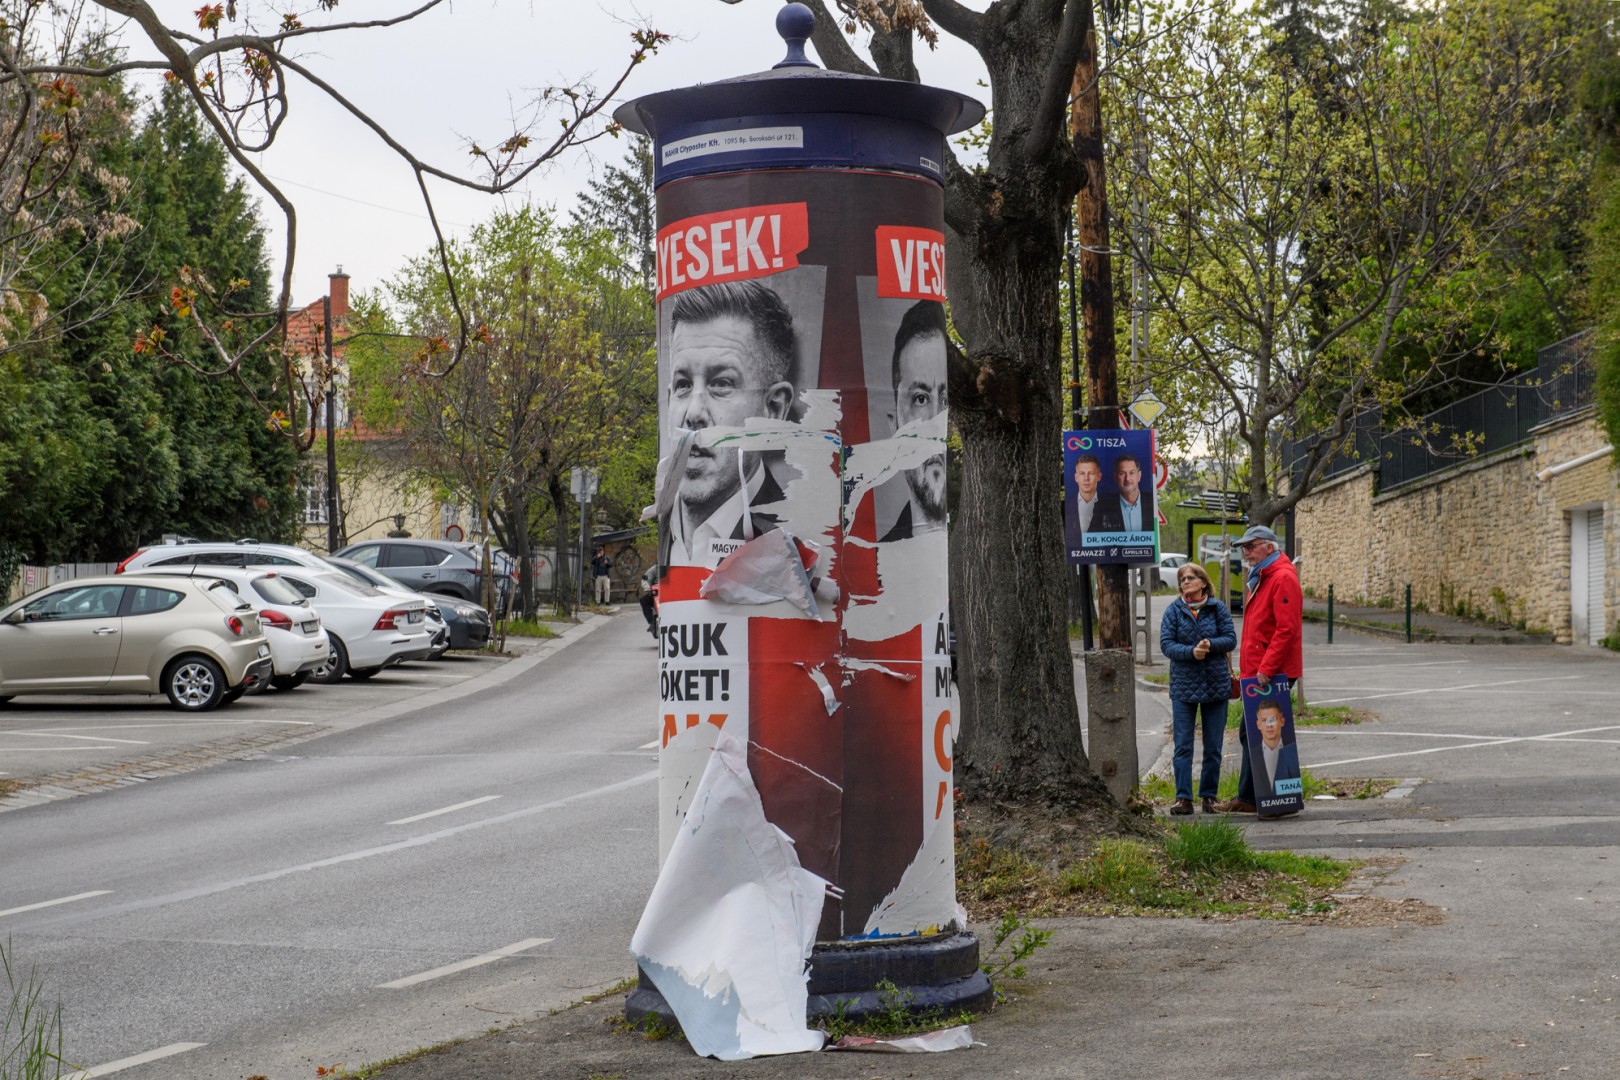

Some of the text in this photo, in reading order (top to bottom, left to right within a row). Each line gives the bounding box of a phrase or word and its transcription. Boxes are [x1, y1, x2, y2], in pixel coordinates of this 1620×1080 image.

[680, 142, 707, 153] Cityposter
[708, 138, 720, 147] Kft.
[1096, 438, 1127, 448] TISZA
[1086, 534, 1152, 544] DR. KONCZ ÁRON
[711, 543, 743, 554] MAGYA
[1071, 549, 1106, 558] SZAVAZZ!
[1261, 797, 1297, 808] SZAVAZZ!
